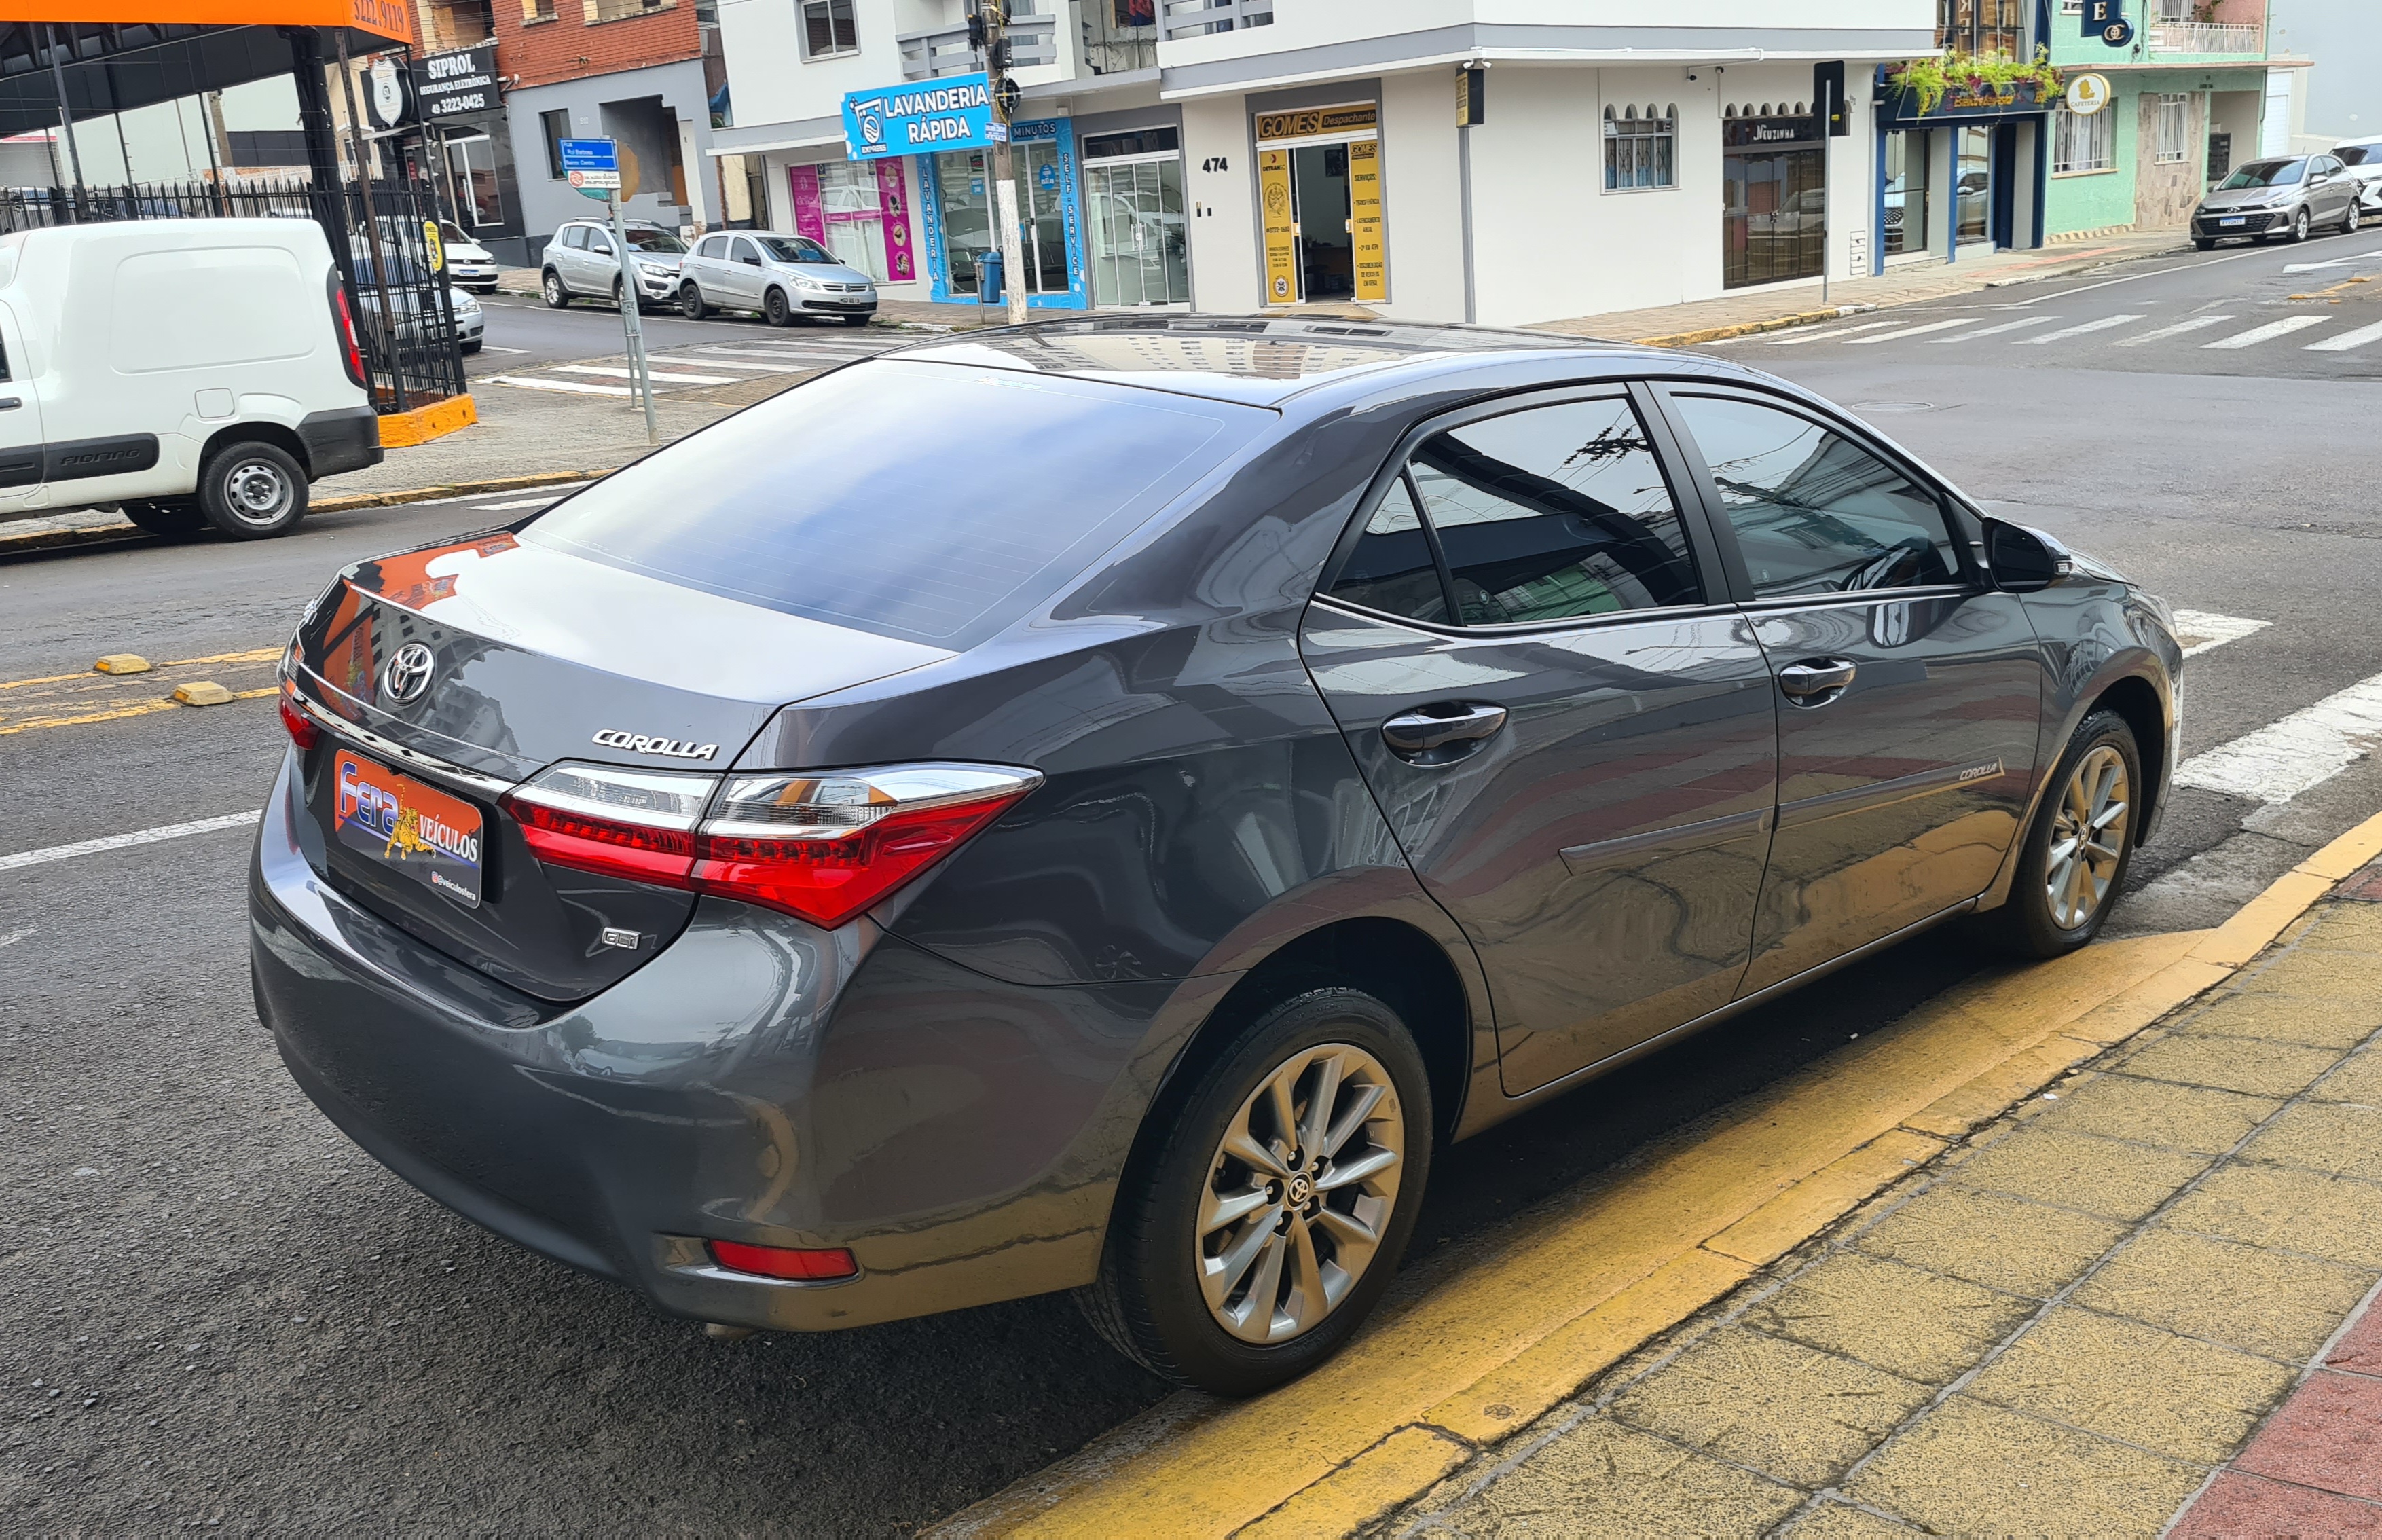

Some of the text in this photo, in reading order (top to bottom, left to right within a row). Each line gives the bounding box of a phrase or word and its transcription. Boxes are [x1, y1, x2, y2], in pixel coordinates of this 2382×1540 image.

[427, 54, 475, 79] SIPROL
[420, 75, 492, 95] SEGURANÇA ELETRÔNICA
[432, 94, 485, 114] 49 3223-0425
[884, 84, 989, 118] LAVANDERIA
[907, 115, 971, 144] RÁPIDA
[1013, 123, 1056, 138] MINUTOS
[1260, 111, 1376, 137] GOMES Despachante
[861, 144, 887, 154] EXPRESS
[1351, 143, 1377, 154] GOMES
[1202, 157, 1228, 173] 474
[921, 168, 940, 281] LAVANDERIA
[591, 729, 719, 760] COROLLA
[1959, 763, 1997, 781] COROLLA
[420, 814, 478, 862] VEÍCULOS
[437, 875, 476, 901] @veiculosfera
